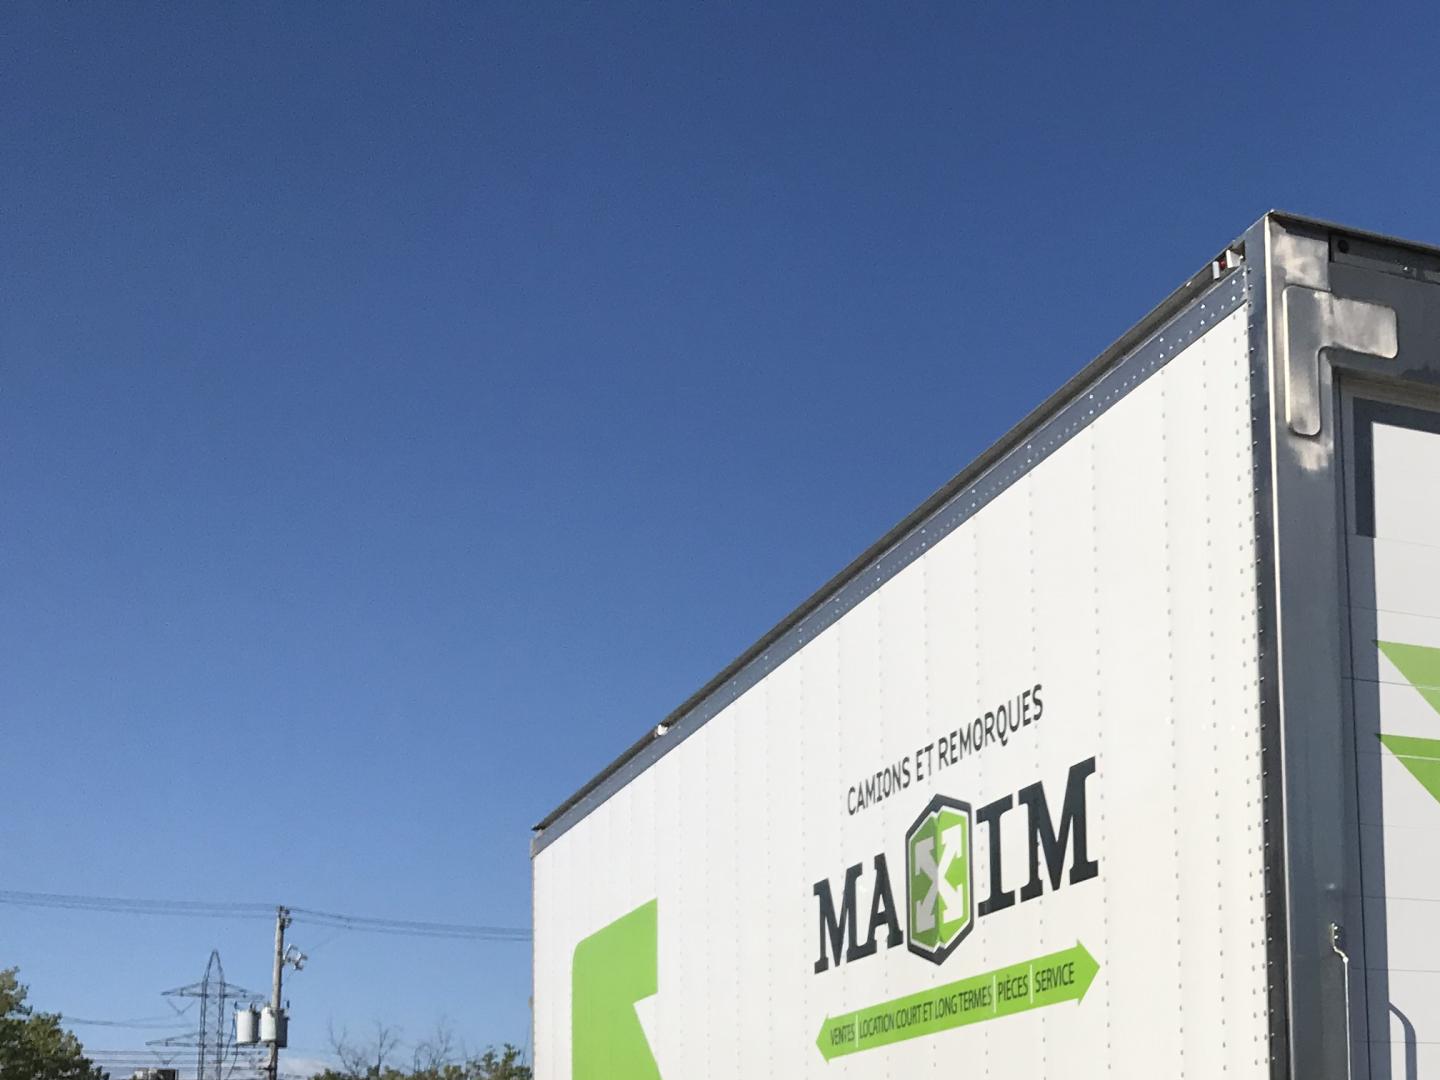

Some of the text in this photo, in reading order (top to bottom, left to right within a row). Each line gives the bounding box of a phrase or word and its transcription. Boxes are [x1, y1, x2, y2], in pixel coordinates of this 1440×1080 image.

[847, 683, 1044, 815] CAMIONS ET REMORQUES
[813, 755, 1099, 974] MAXIM
[830, 962, 1075, 1046] VENTES LOCATION COURT ET LONG TERMES PIÈCES SERVICE
